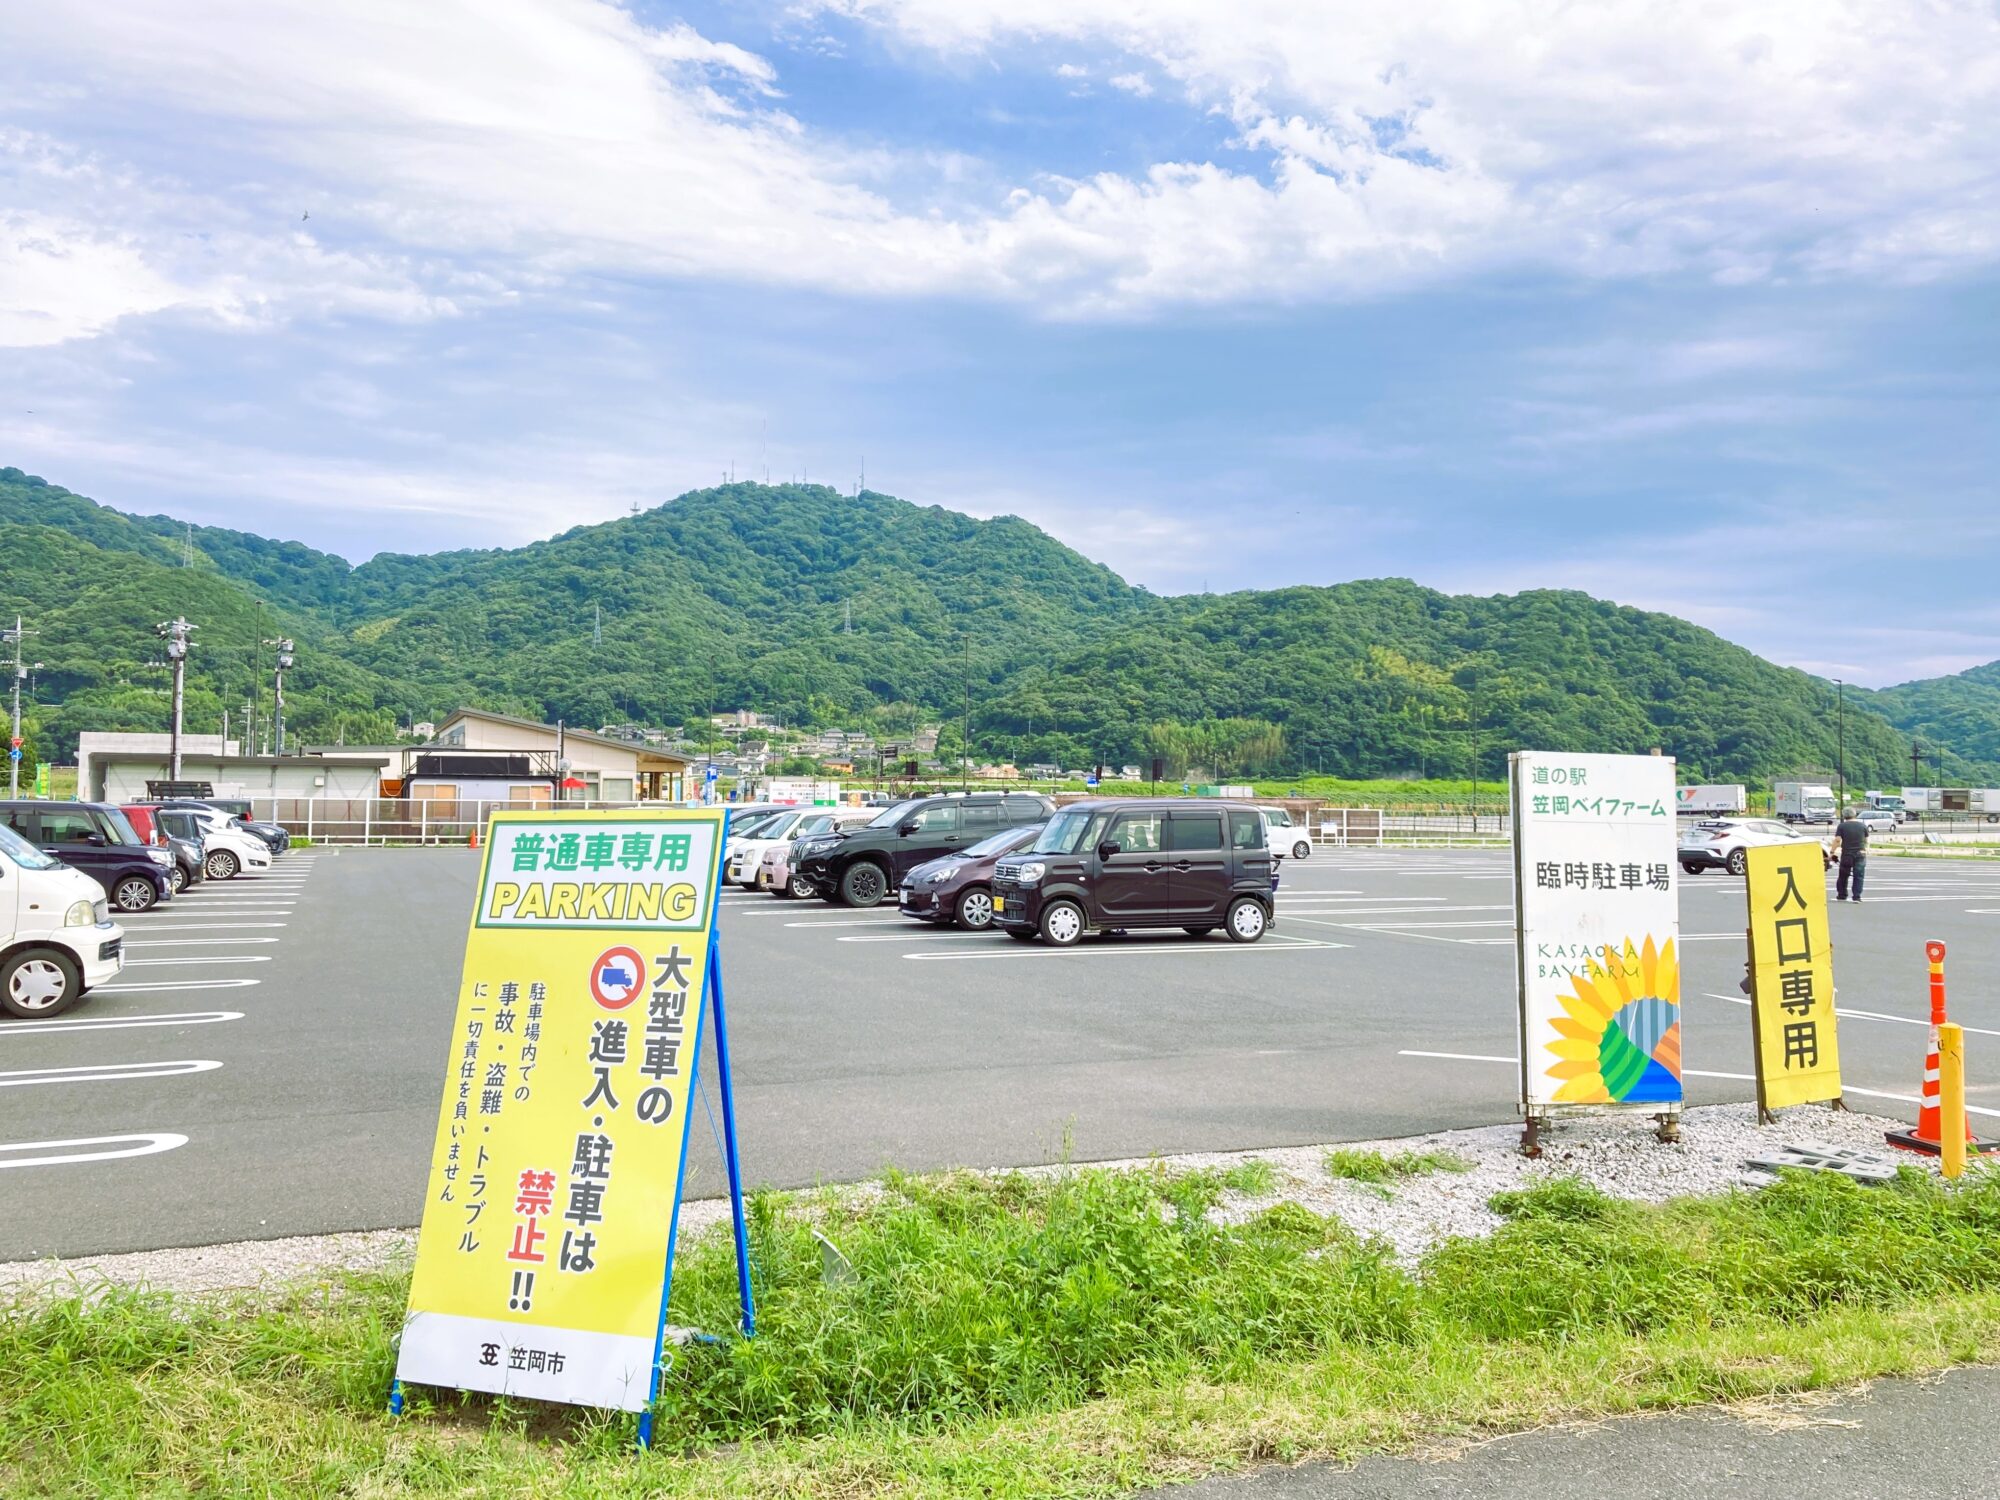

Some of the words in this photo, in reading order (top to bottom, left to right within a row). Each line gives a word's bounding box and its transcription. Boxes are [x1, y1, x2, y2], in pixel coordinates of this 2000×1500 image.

[1532, 766, 1587, 786] 道の駅
[1532, 794, 1667, 817] 笠岡ベイファーム
[511, 832, 691, 872] 普通車専用
[1536, 861, 1670, 891] 臨時駐車場
[489, 882, 697, 921] PARKING
[1538, 943, 1639, 959] KASAOKA
[1774, 866, 1818, 1070] 入口専用
[1538, 964, 1640, 980] BAYFARM
[515, 982, 546, 1102] 駐車場内での
[637, 946, 692, 1125] 大型車の
[440, 982, 488, 1202] に一切責任を負いません
[458, 982, 519, 1252] 事故・盗難・トラブル
[560, 1020, 628, 1272] 進入・駐車は
[508, 1348, 566, 1375] 笠岡市
